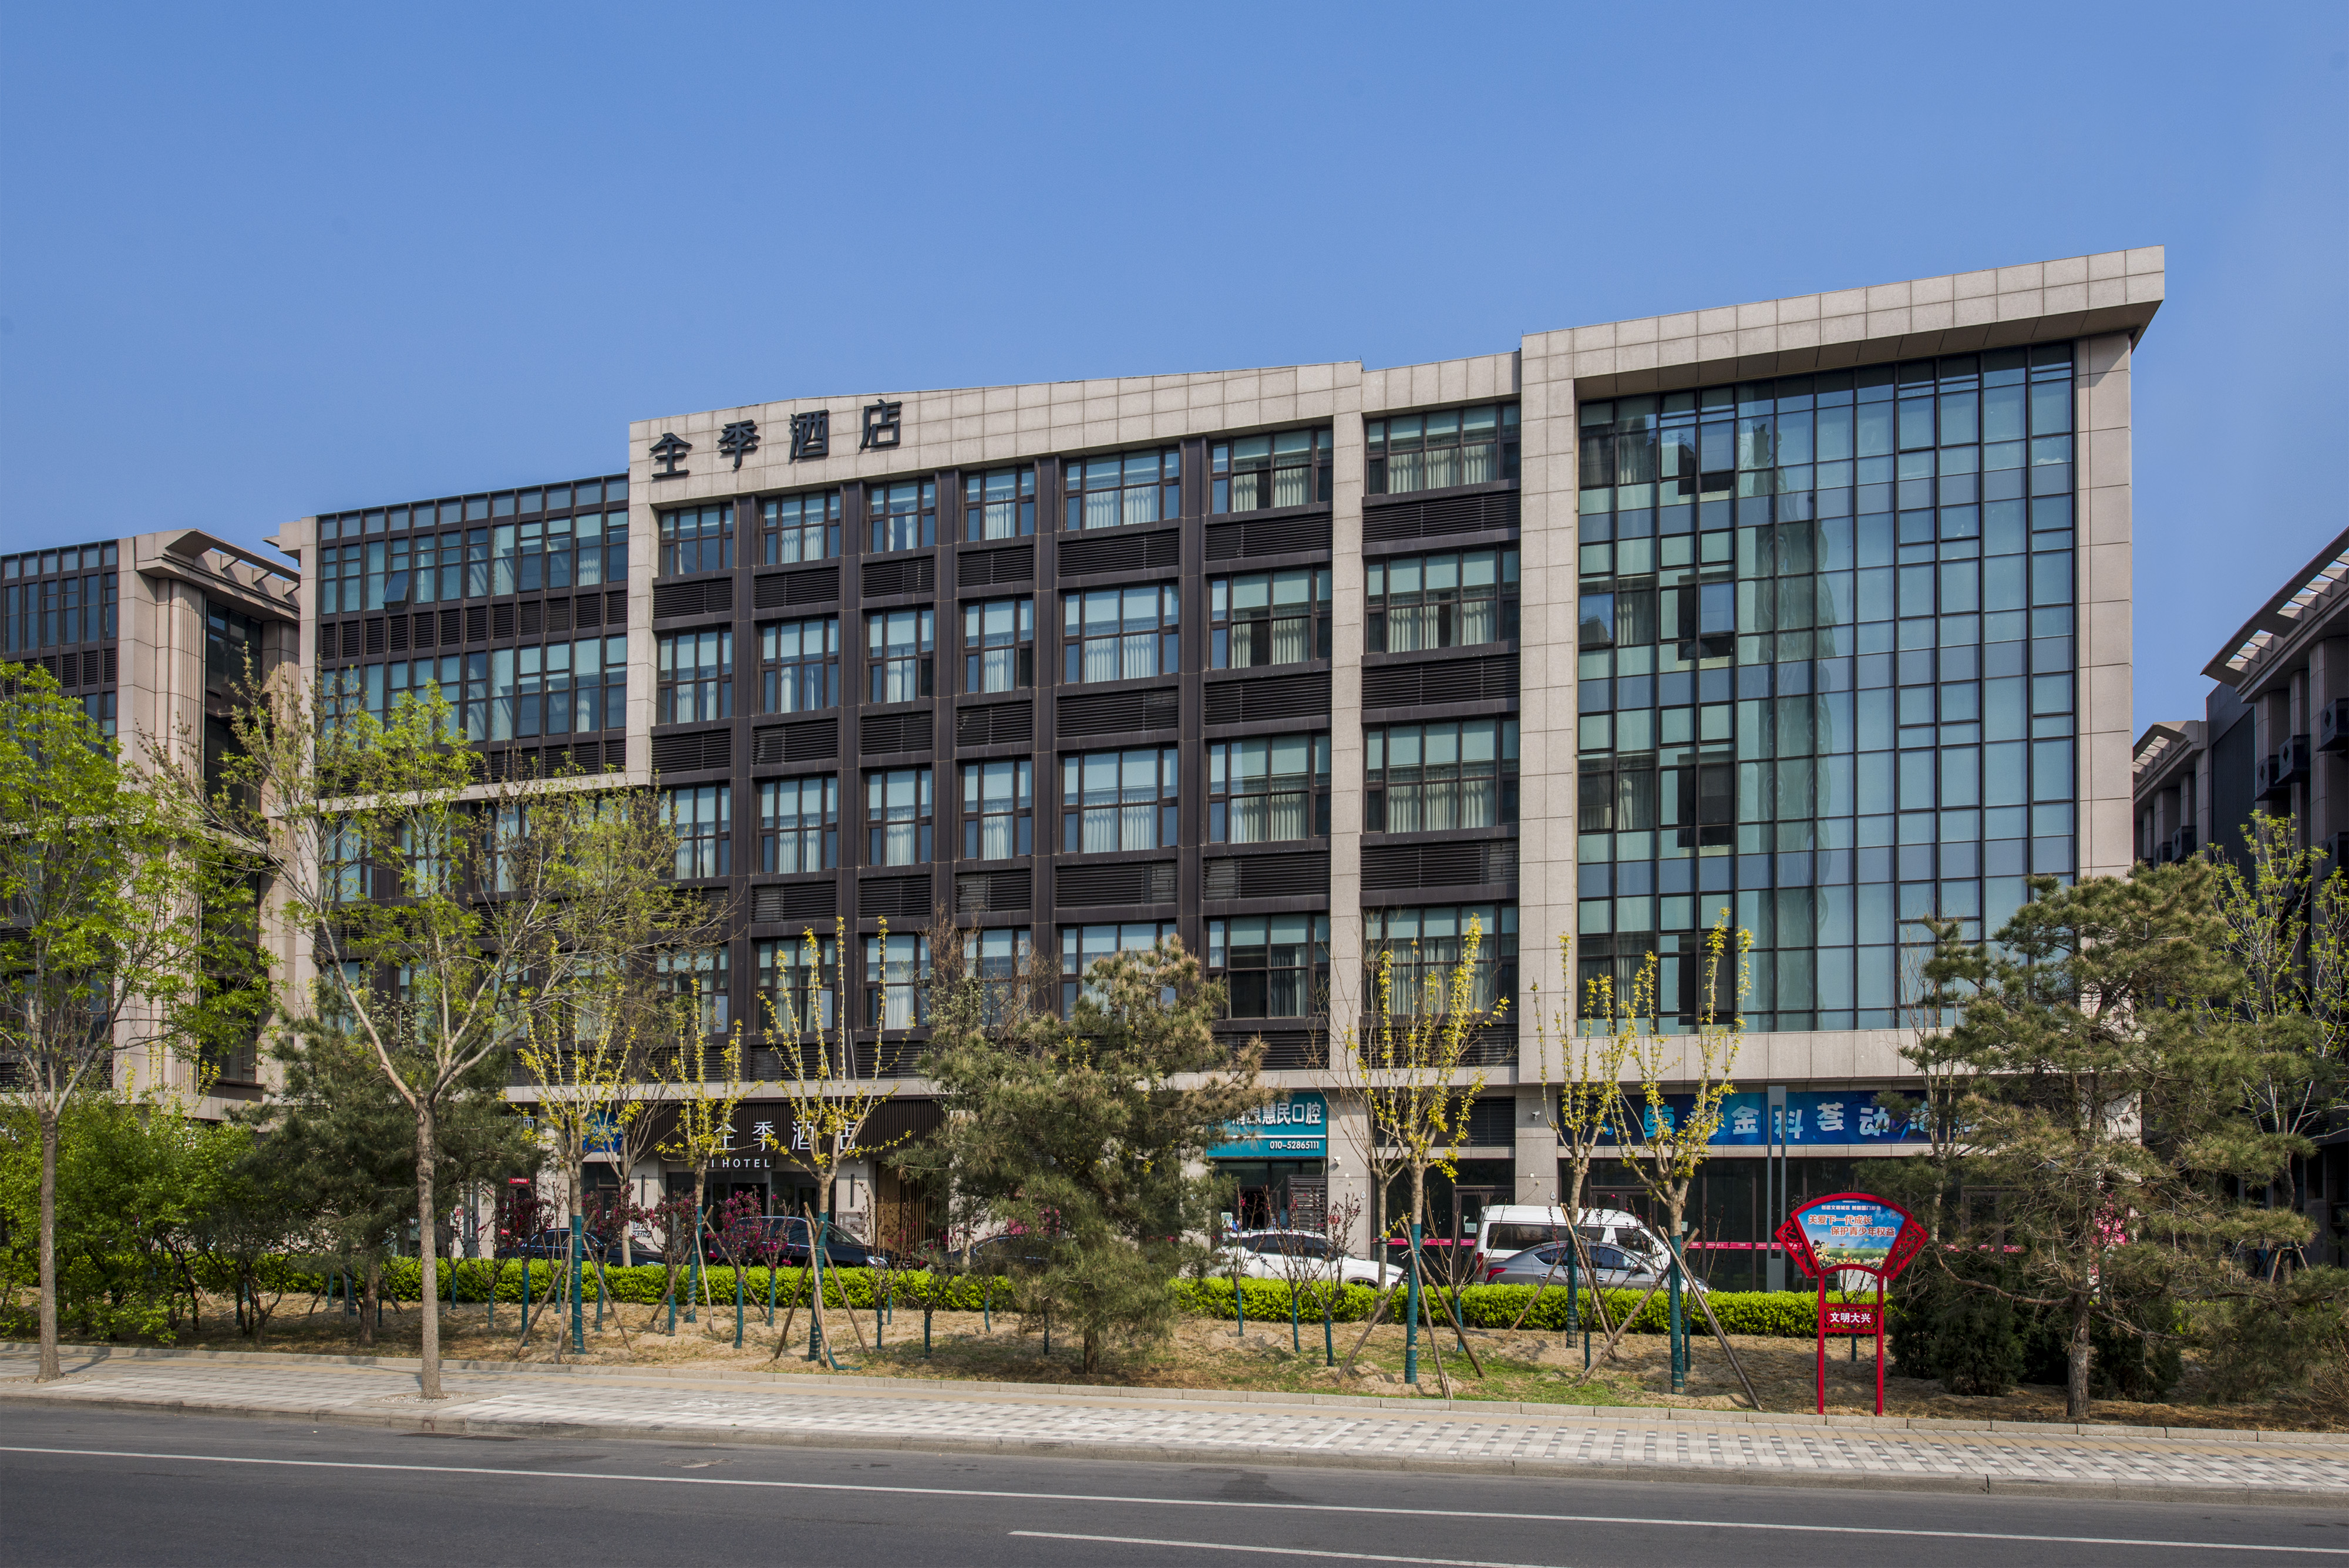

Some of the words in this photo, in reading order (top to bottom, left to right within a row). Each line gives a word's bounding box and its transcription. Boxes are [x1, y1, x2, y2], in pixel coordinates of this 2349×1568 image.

[649, 399, 903, 479] 全季酒店
[1270, 1141, 1319, 1149] 010-52865111
[722, 1158, 770, 1168] HOTEL
[1808, 1214, 1873, 1225] 关爱下一代成长
[1830, 1226, 1896, 1237] 保护青少年权益
[1830, 1312, 1871, 1323] 文明大兴
